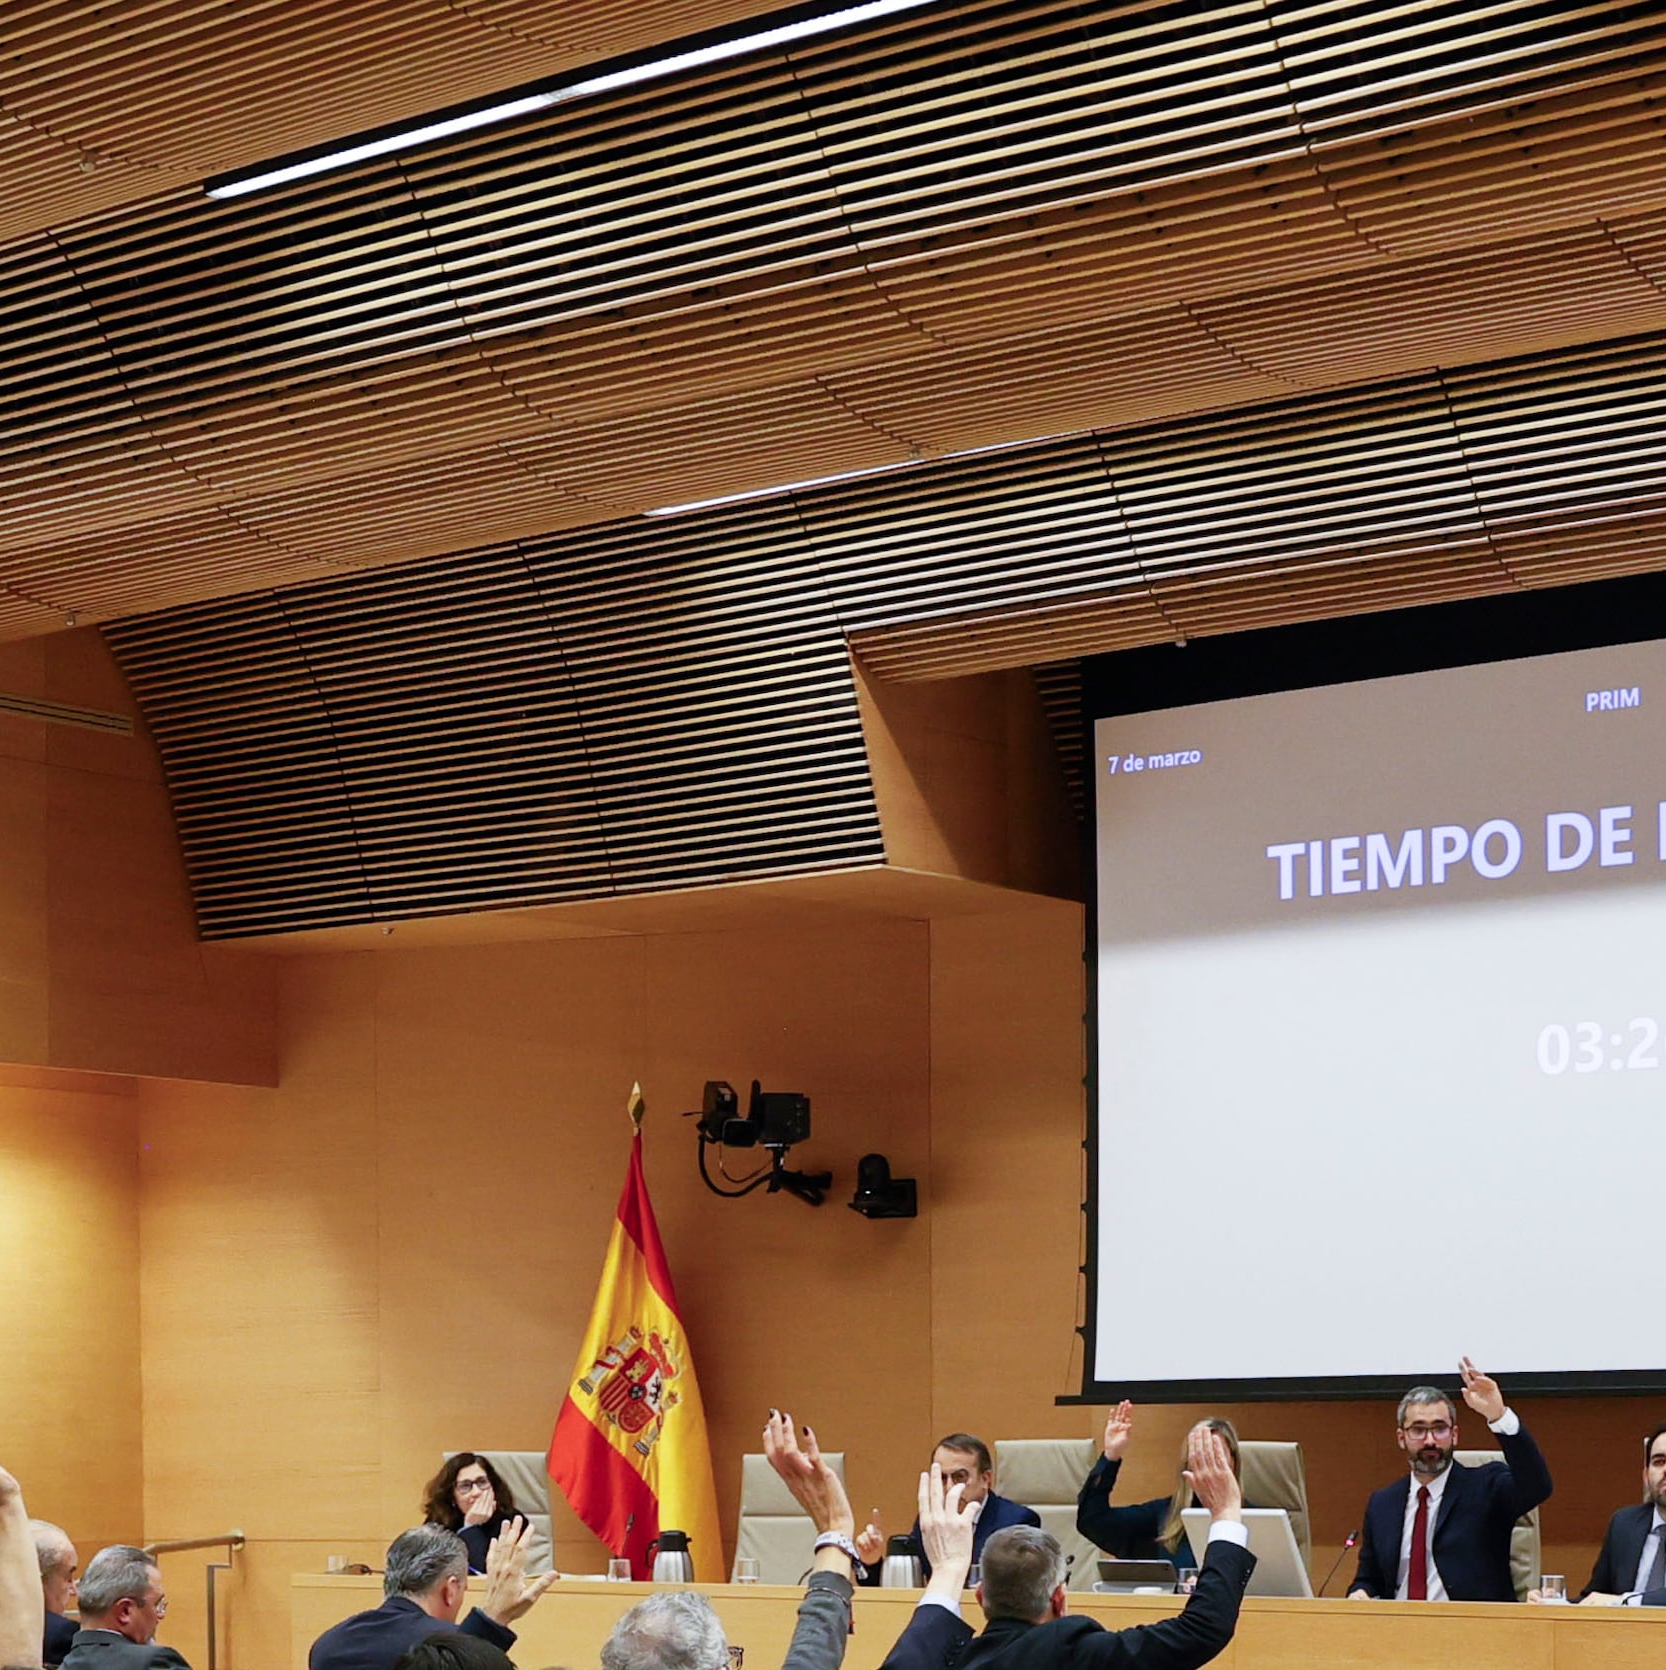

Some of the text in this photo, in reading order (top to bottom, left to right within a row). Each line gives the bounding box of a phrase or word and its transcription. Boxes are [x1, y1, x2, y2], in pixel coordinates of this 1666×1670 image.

[1586, 686, 1641, 712] PRIM
[1108, 750, 1202, 774] 7 de marzo
[1266, 819, 1523, 900] TIEMPO
[1546, 805, 1634, 872] DE
